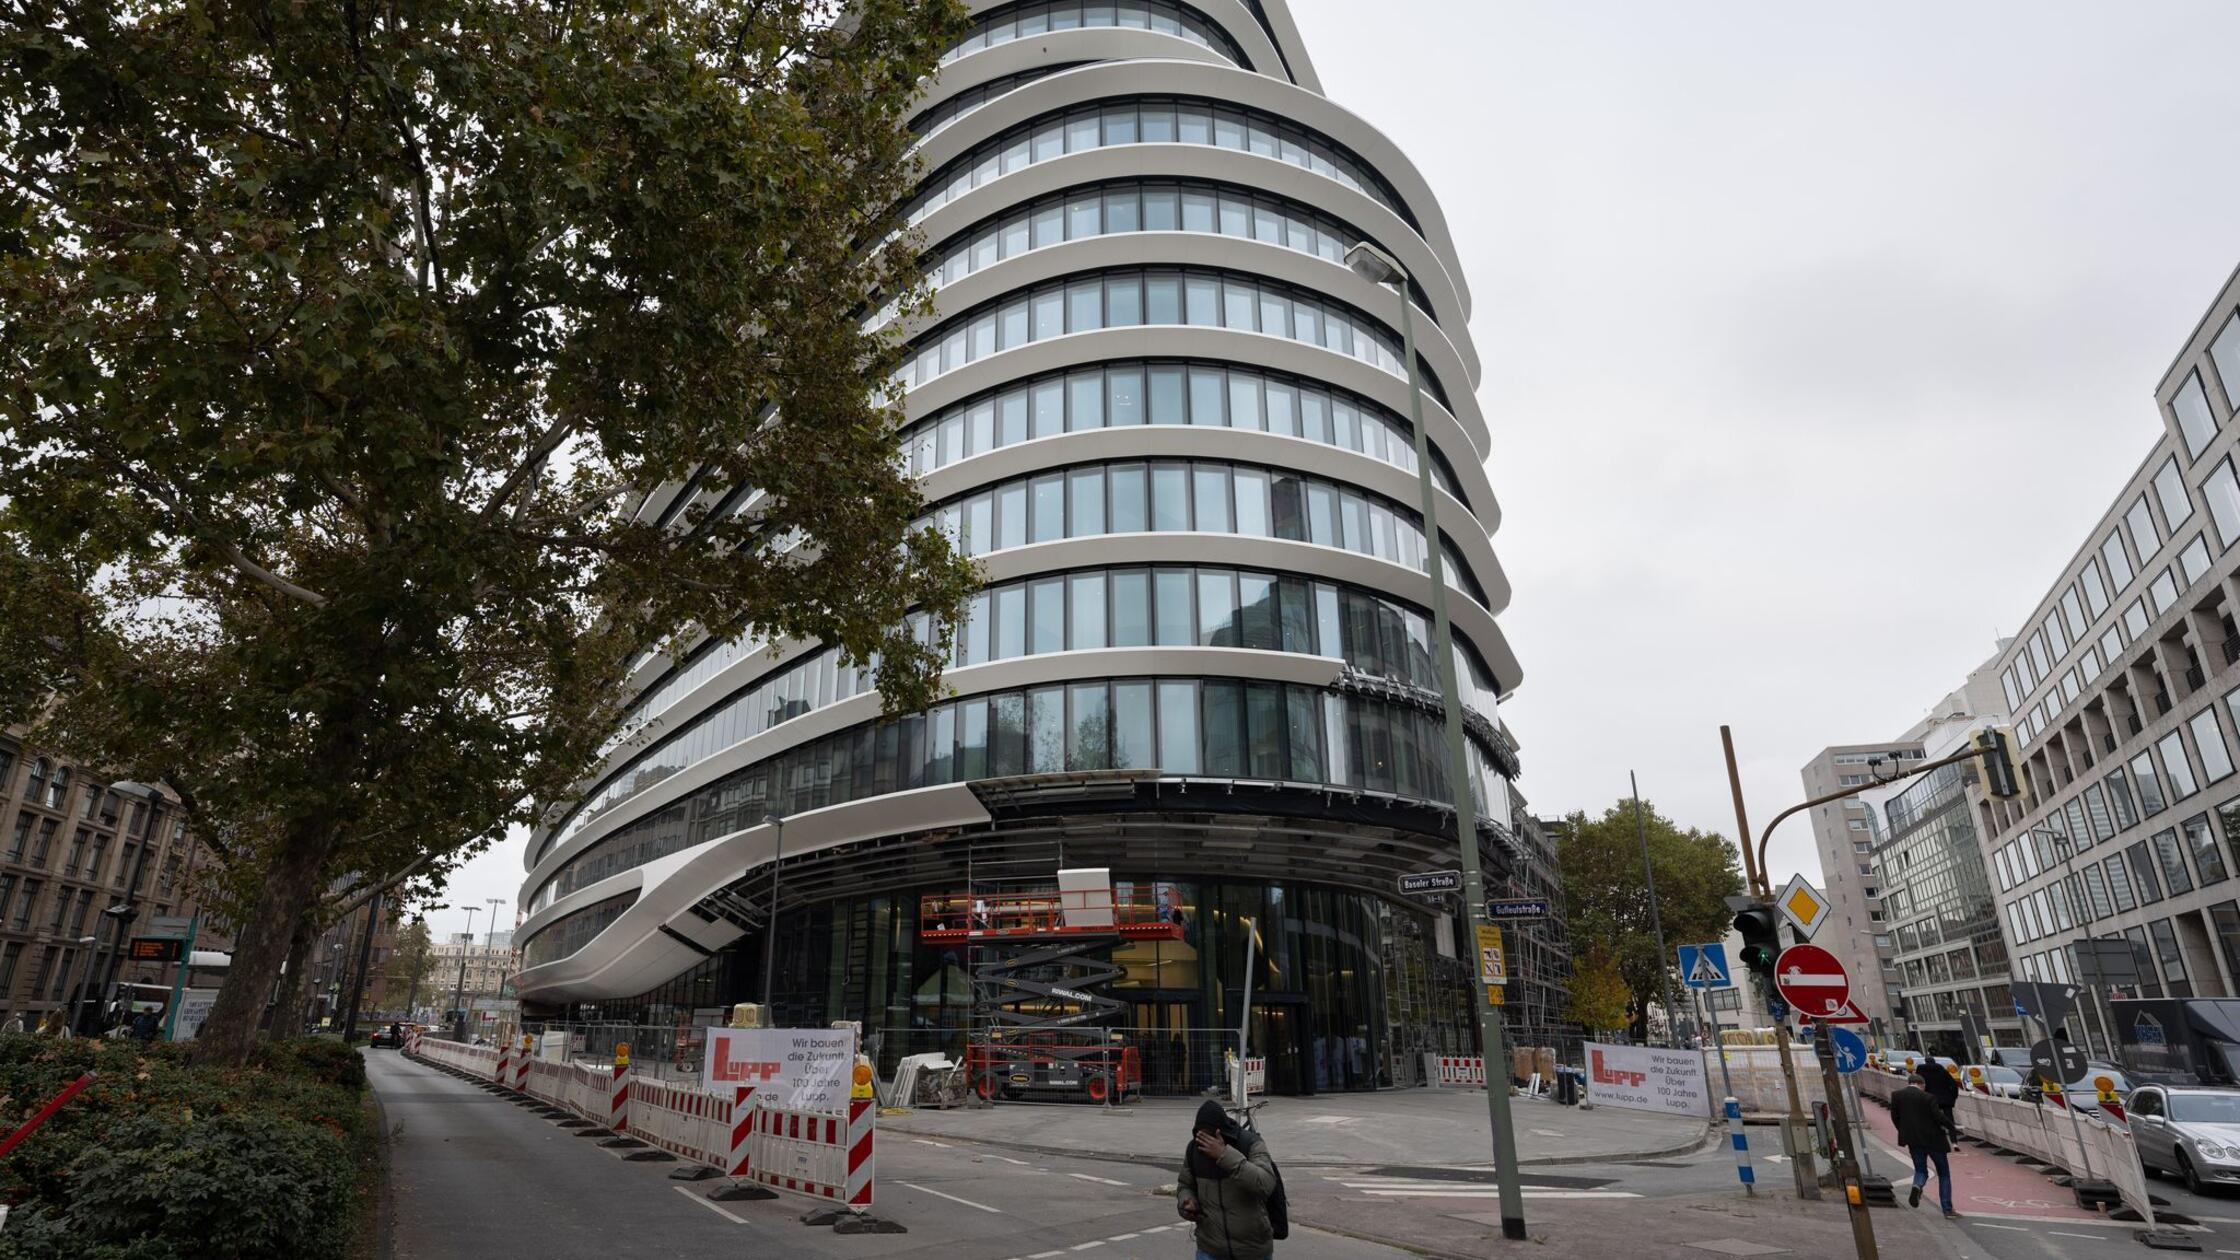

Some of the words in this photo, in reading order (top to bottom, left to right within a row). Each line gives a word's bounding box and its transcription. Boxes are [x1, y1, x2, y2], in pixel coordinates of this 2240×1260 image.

[1404, 878, 1429, 889] Baseler
[1431, 876, 1454, 887] Straße
[792, 1038, 809, 1048] Wir
[811, 1038, 844, 1048] bauen
[787, 1051, 805, 1061] die
[1651, 1054, 1664, 1063] Wir
[1667, 1055, 1695, 1066] bauen
[1650, 1065, 1664, 1074] die
[792, 1078, 809, 1088] 100
[813, 1077, 841, 1088] Jahre
[1665, 1075, 1686, 1086] Über
[1593, 1091, 1648, 1104] www.lupp.de
[1656, 1087, 1671, 1096] 100
[1673, 1088, 1698, 1098] Jahre
